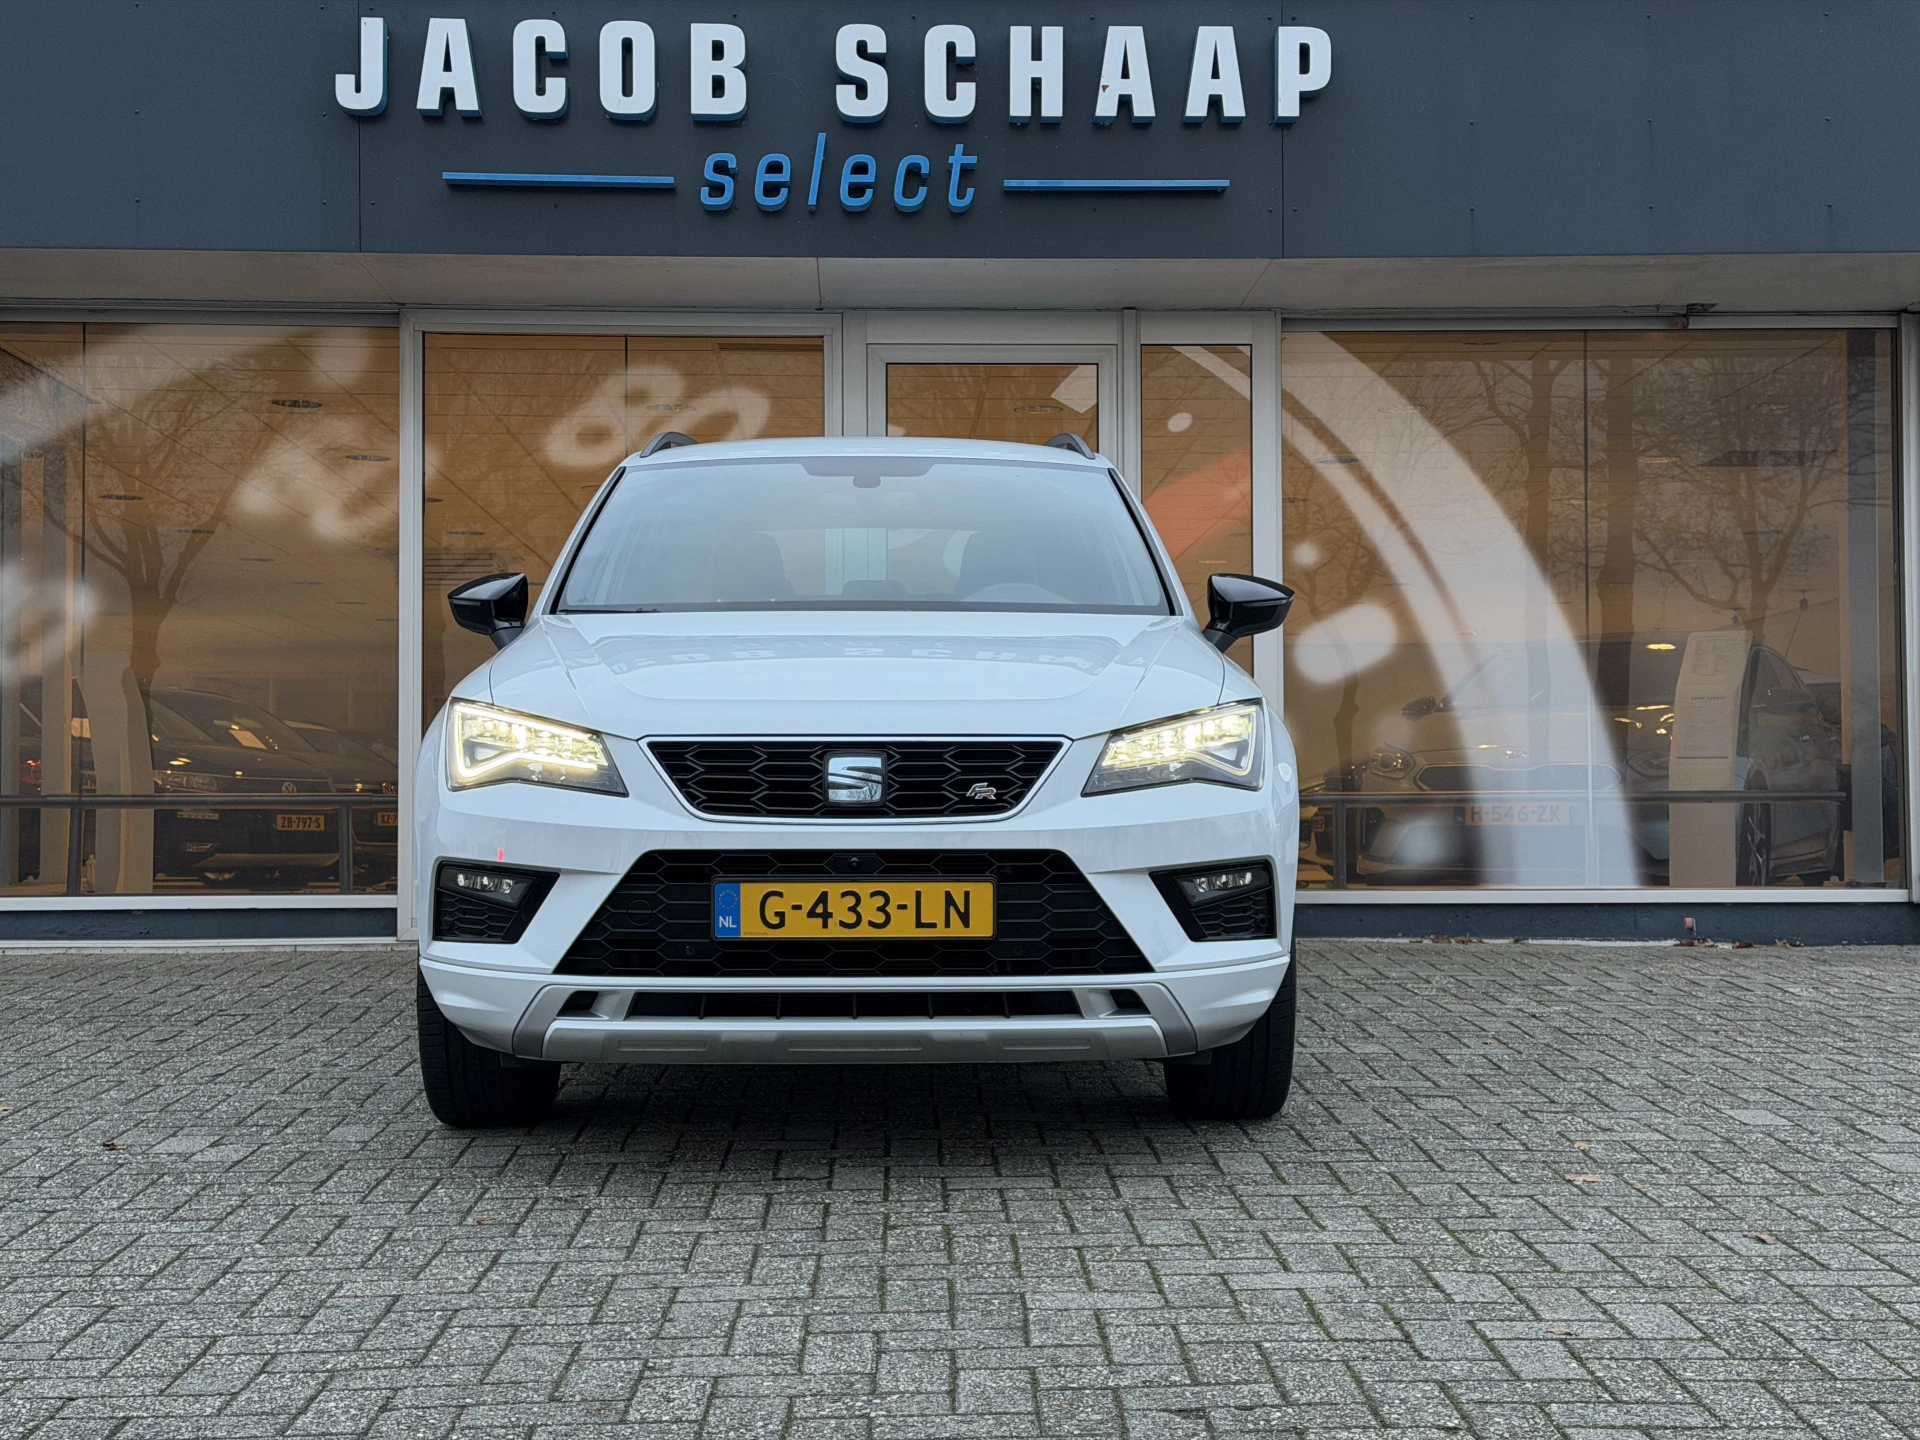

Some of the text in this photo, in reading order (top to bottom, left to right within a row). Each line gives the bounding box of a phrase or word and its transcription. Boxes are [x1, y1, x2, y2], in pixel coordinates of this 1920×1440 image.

[334, 16, 1333, 123] JACOB SCHAAP
[699, 132, 978, 213] select
[966, 782, 997, 800] FR
[1471, 804, 1562, 823] H-546-ZK
[718, 915, 738, 929] NL
[758, 889, 971, 930] G-433-LN
